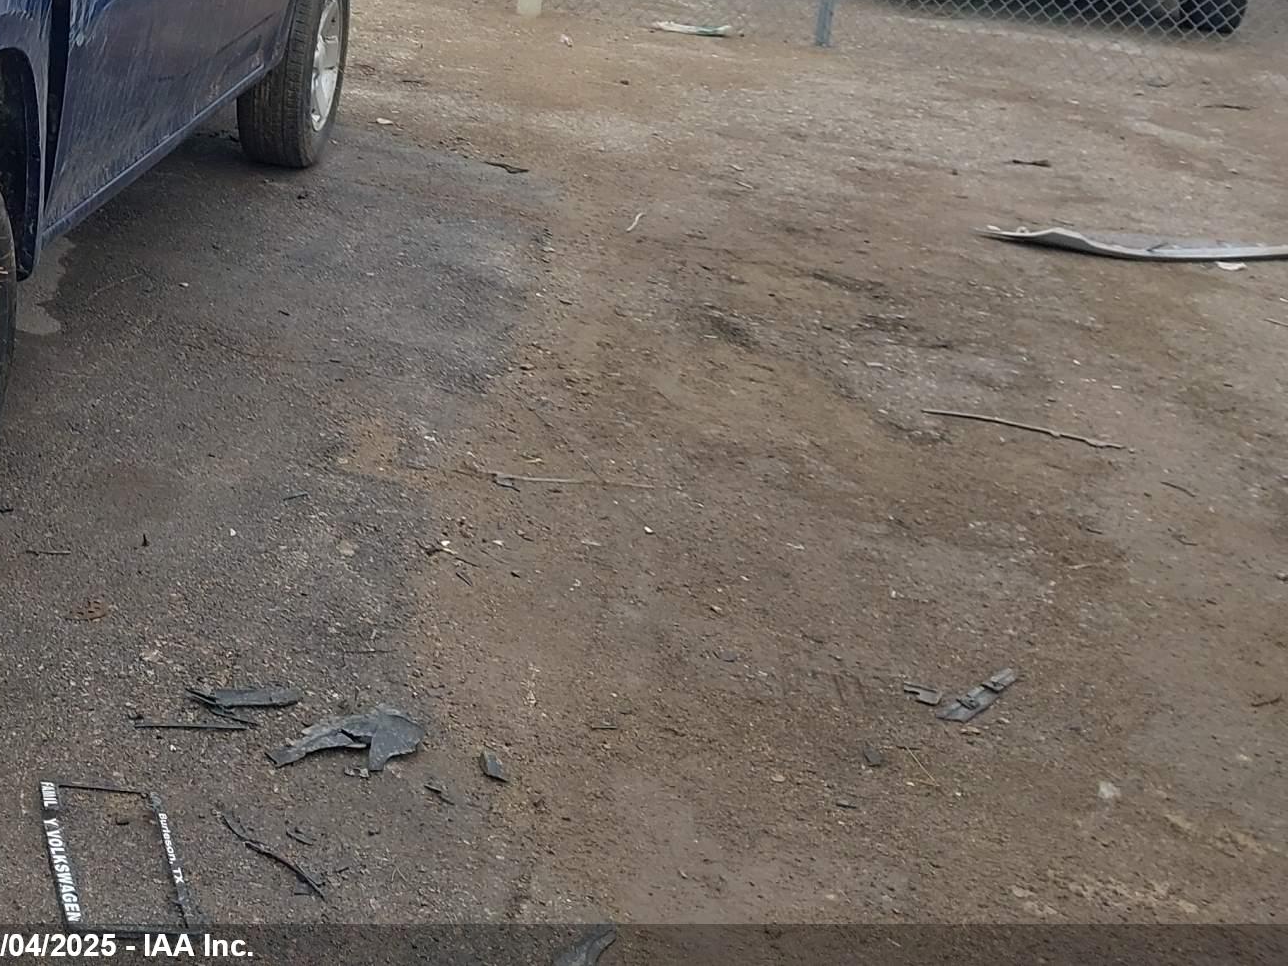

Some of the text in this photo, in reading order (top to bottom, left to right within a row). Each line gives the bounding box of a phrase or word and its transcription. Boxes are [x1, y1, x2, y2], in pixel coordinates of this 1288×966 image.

[45, 828, 82, 922] VOLKSWAGEN
[158, 812, 185, 884] Burleson, TX
